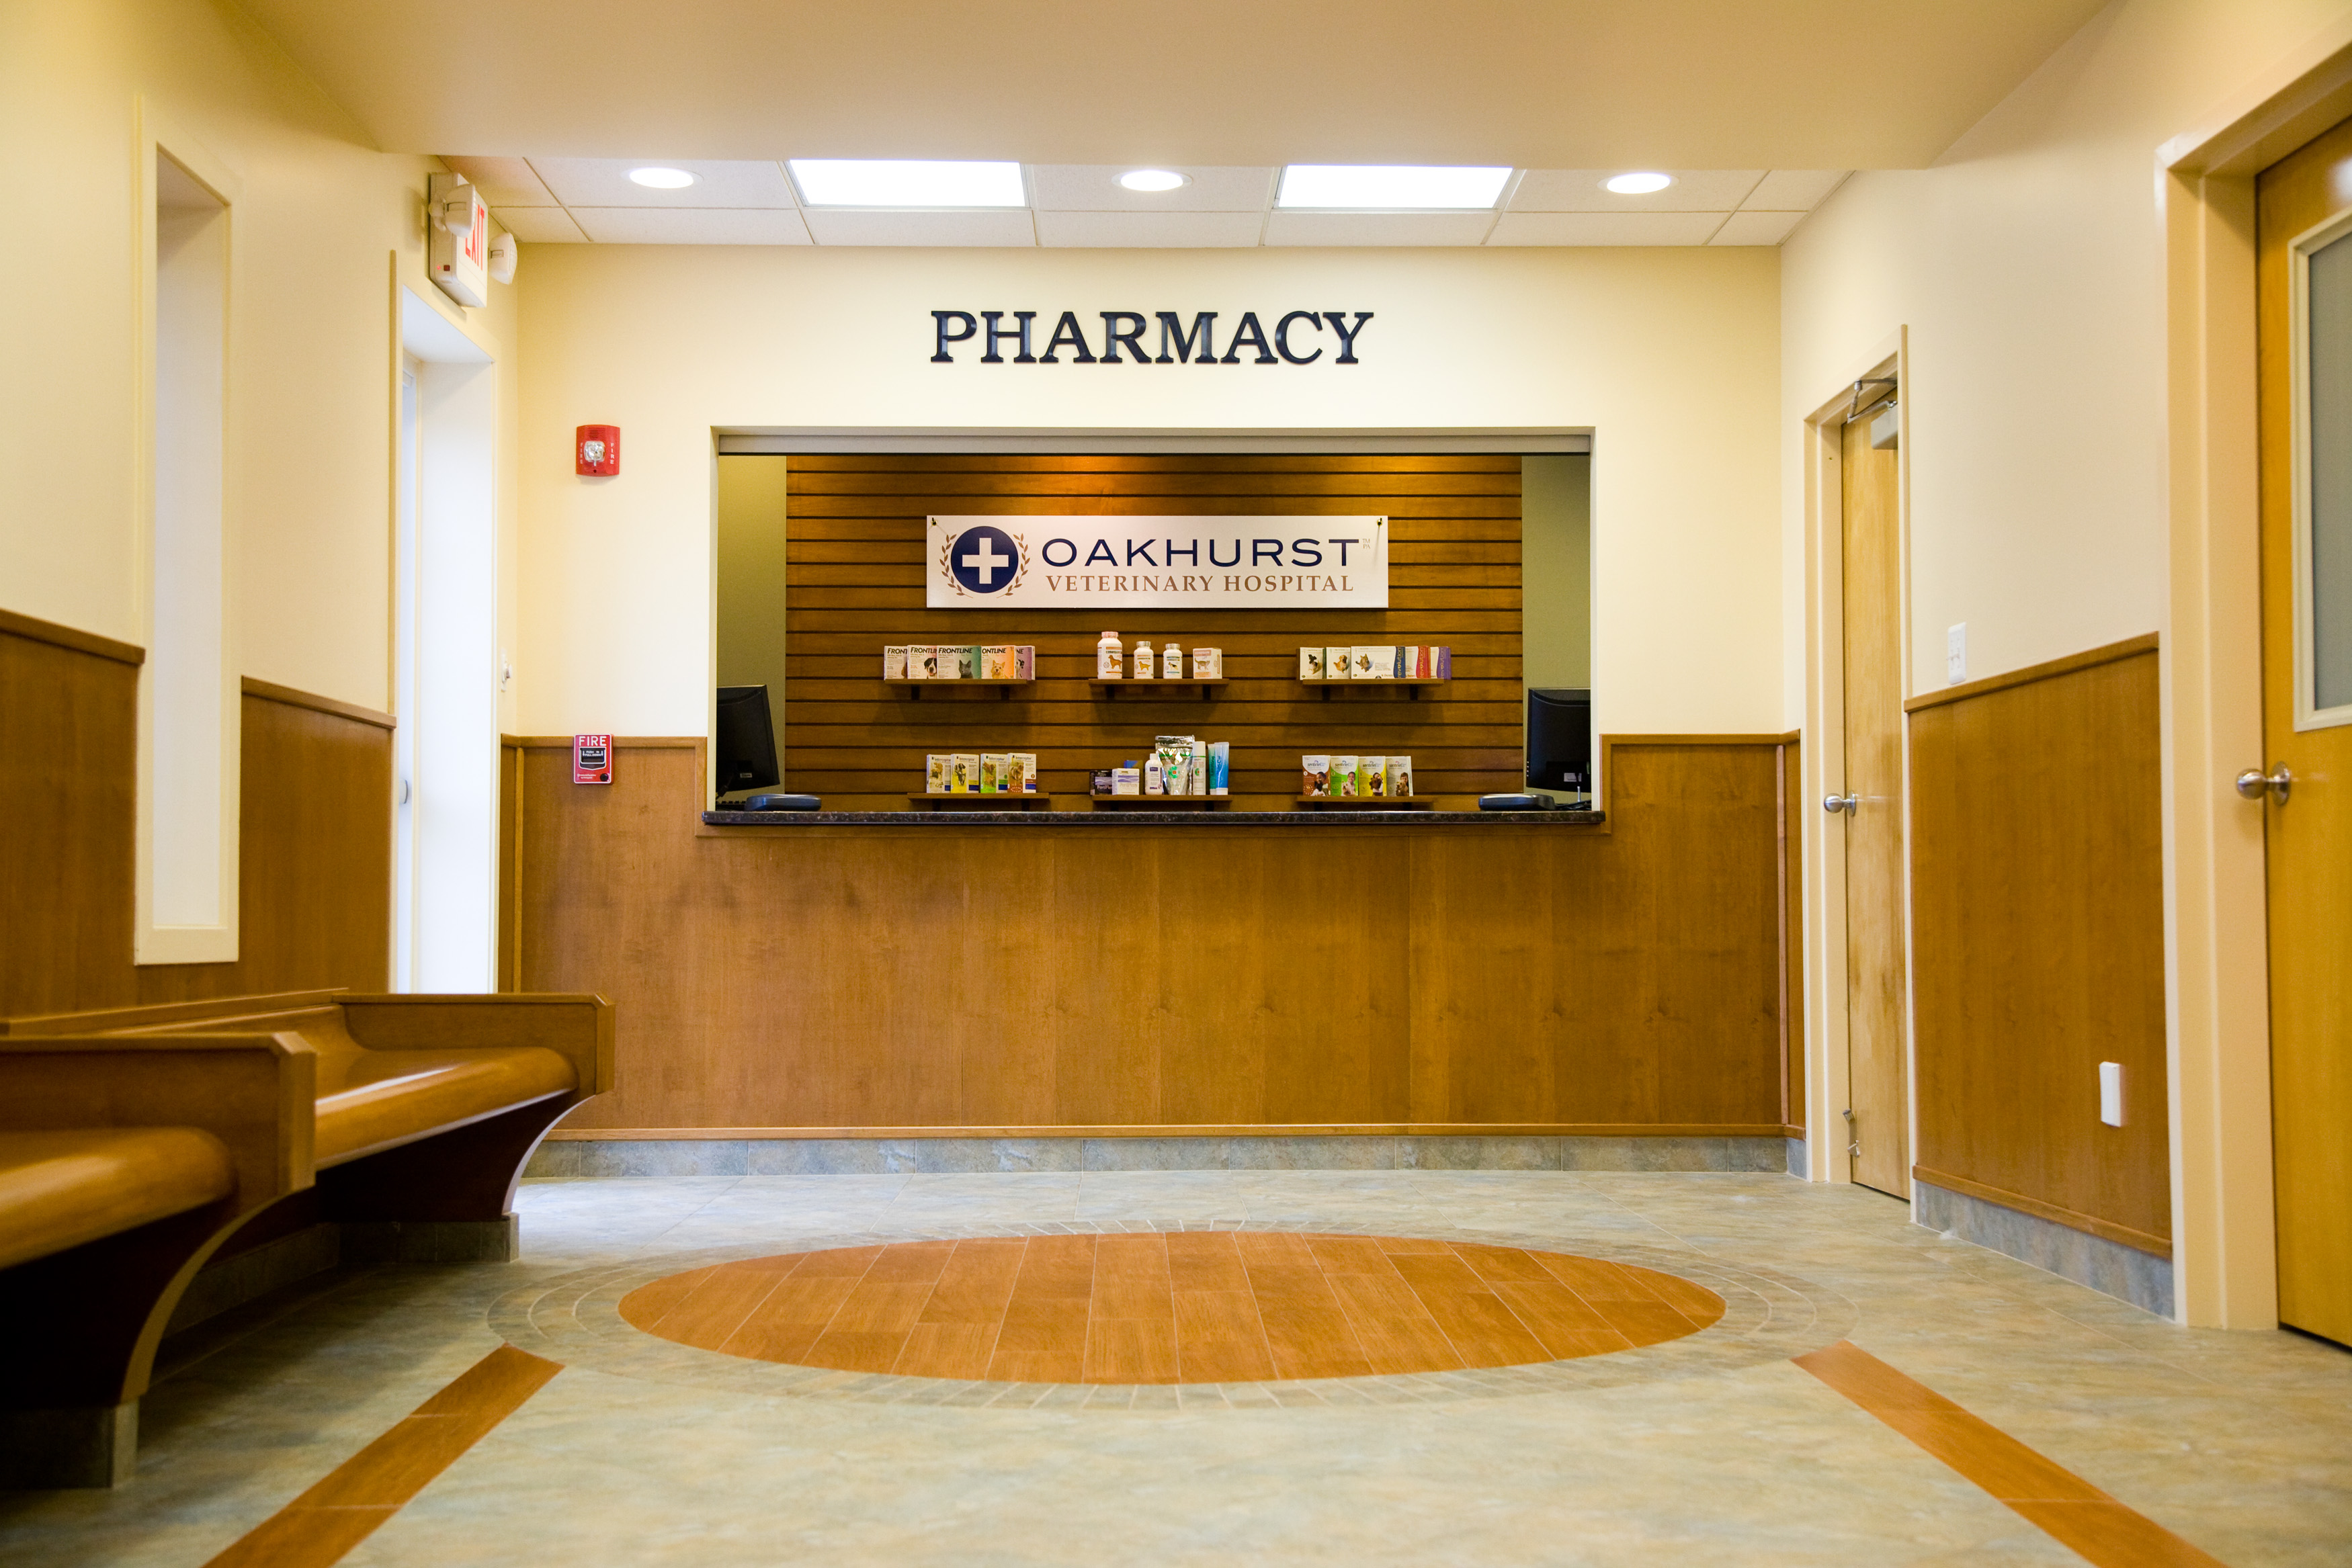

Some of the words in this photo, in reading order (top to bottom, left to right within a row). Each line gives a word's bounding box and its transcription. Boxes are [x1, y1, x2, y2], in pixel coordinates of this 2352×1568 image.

[931, 311, 1374, 364] PHARMACY
[1042, 539, 1359, 567] OAKHURST
[1046, 576, 1213, 591] VETERINARY
[1224, 576, 1353, 591] HOSPITAL
[579, 736, 607, 746] FIRE
